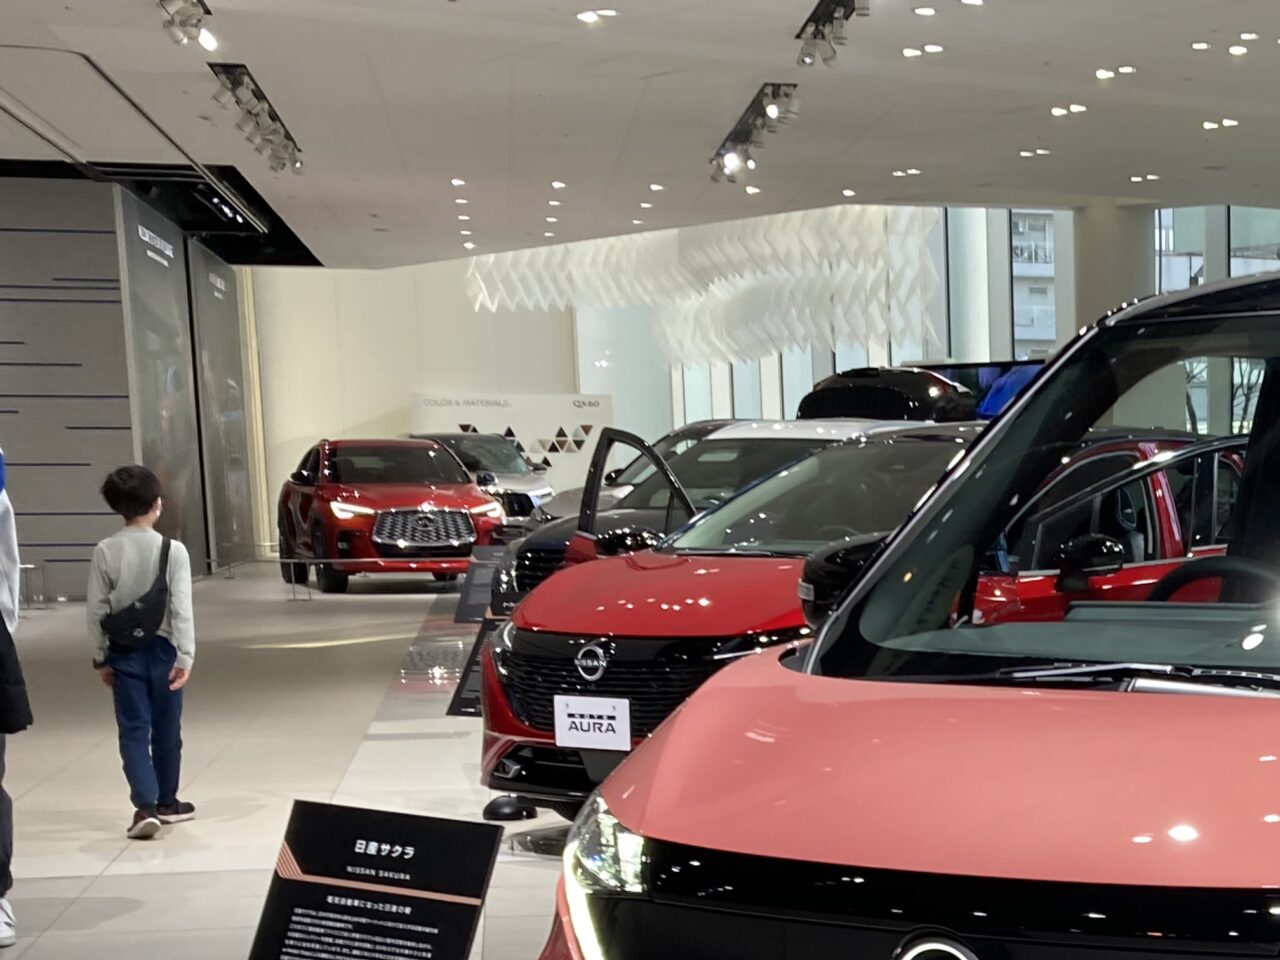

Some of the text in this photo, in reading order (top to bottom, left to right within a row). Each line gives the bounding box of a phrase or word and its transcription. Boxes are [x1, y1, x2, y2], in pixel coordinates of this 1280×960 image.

[573, 400, 600, 409] QX60
[574, 659, 607, 668] NISSAN
[568, 721, 617, 735] AURA
[354, 840, 415, 859] 日産サクラ
[347, 866, 411, 880] NISSAN SAKURA
